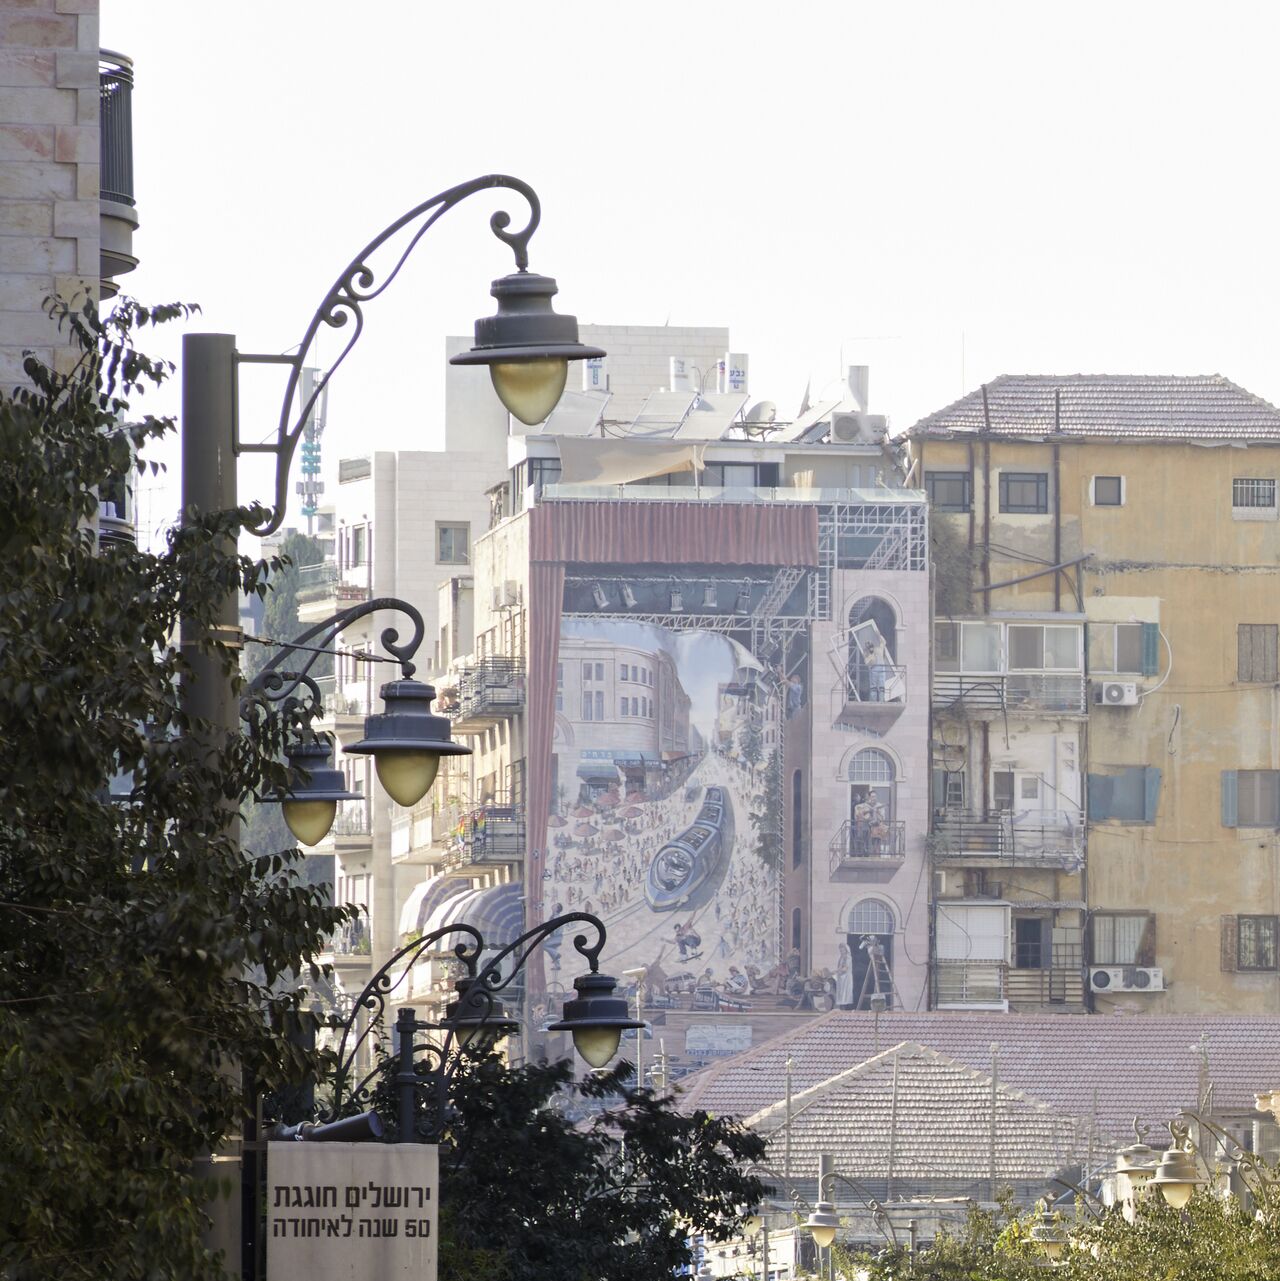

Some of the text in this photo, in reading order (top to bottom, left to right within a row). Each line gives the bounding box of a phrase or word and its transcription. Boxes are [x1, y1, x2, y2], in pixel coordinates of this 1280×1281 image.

[273, 1181, 431, 1208] ירושלים חוגגת
[273, 1214, 431, 1238] 50 שנה לאיחודה
